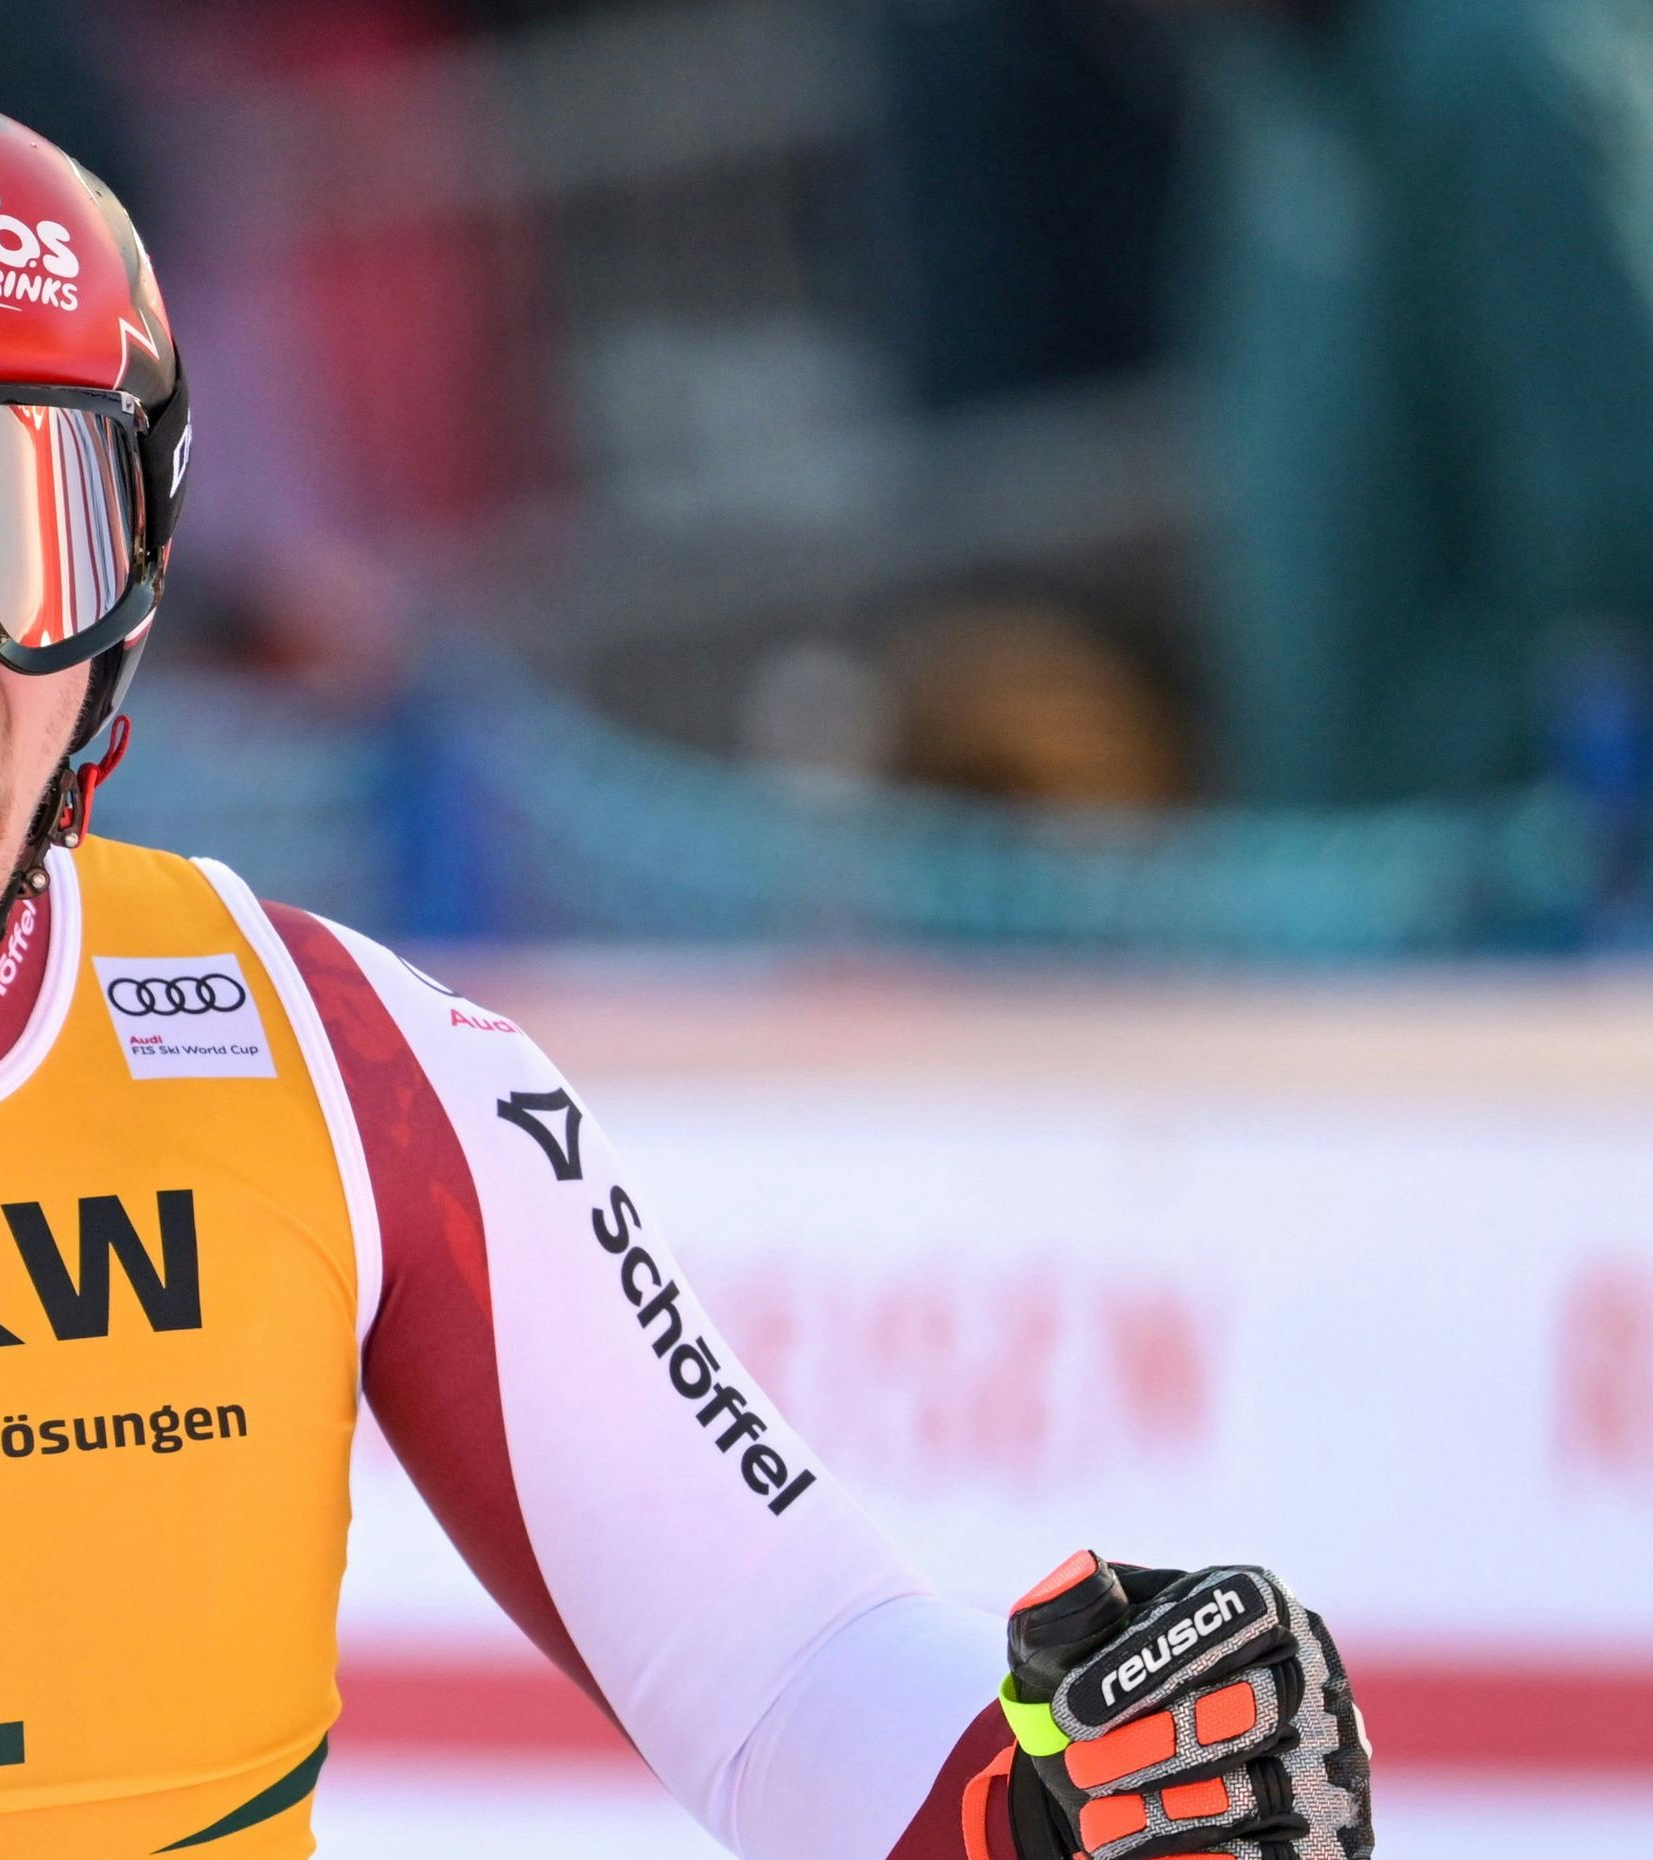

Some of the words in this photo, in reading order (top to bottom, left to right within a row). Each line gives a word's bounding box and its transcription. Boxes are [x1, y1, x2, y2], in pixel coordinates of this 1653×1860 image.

[130, 1035, 163, 1045] Audi
[131, 1045, 156, 1056] FIS
[159, 1045, 180, 1055] Ski
[182, 1045, 227, 1055] World
[230, 1044, 259, 1057] Cup
[591, 1185, 817, 1517] Schöffel
[1100, 1588, 1245, 1707] reusch
